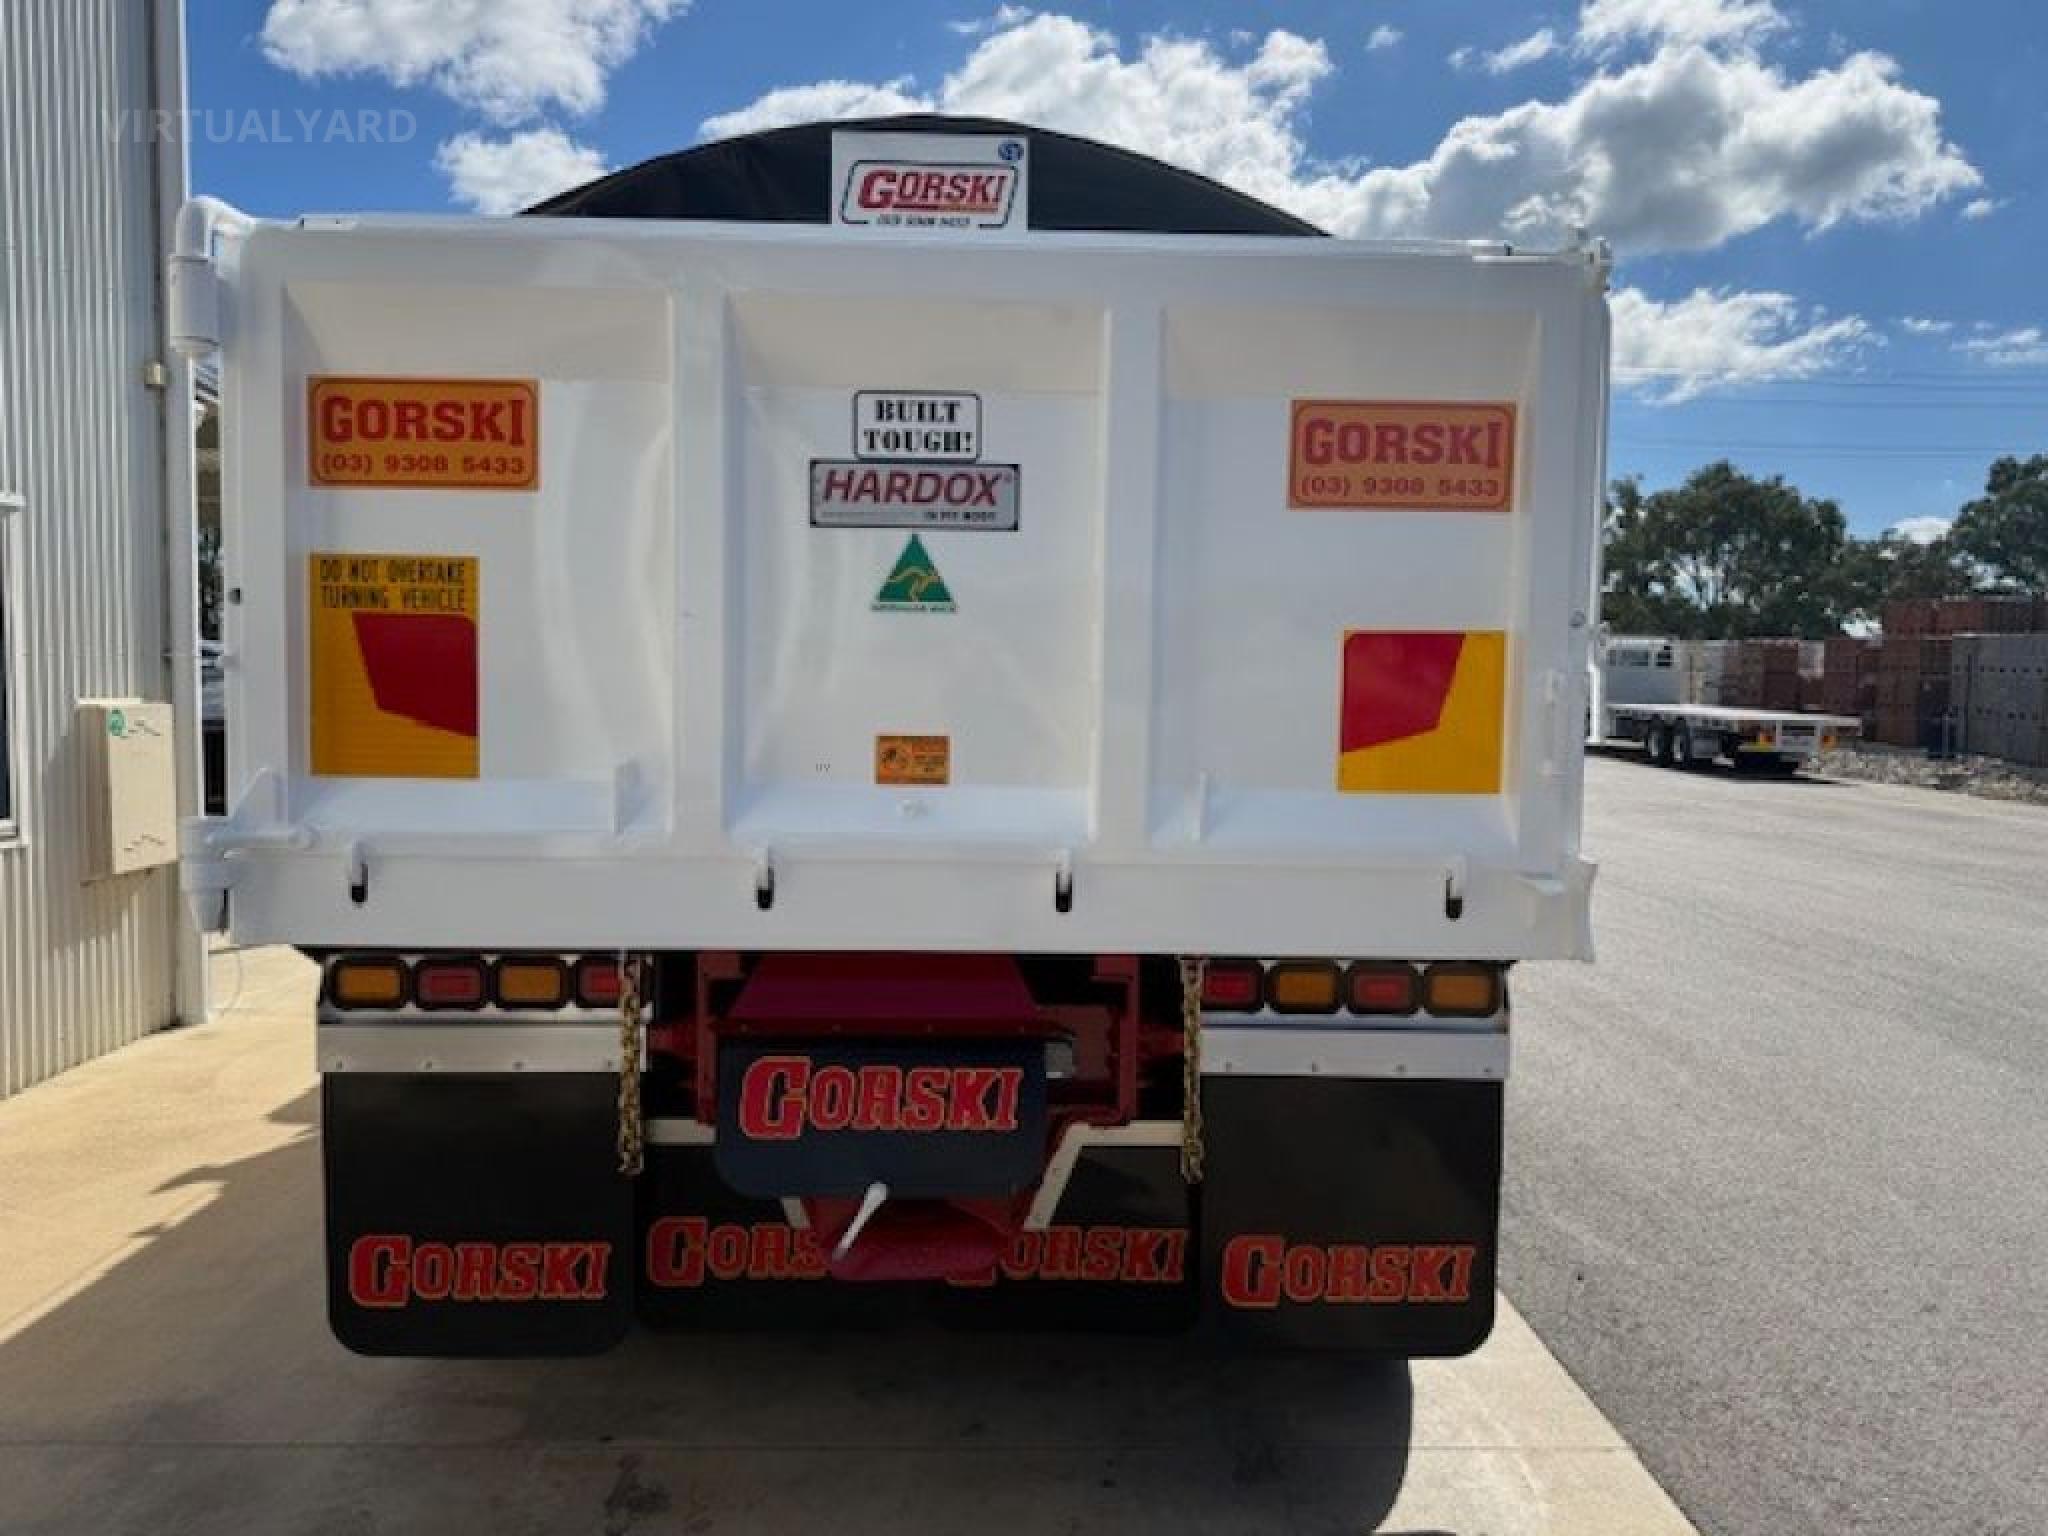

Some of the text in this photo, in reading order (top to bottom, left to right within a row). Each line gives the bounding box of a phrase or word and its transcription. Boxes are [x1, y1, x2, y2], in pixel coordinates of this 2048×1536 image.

[857, 169, 1007, 208] GORSKI
[322, 396, 524, 446] GORSKI
[875, 400, 960, 423] BUILT
[863, 428, 973, 453] TOUGH!
[1304, 418, 1502, 470] GORSKI
[320, 453, 524, 475] (03) 9308 5433
[1301, 475, 1351, 496] (03)
[319, 560, 465, 585] DO NOT OVERTAKE
[320, 586, 465, 611] TURNING VEHICLE
[739, 1056, 1023, 1140] GORSKI
[349, 1235, 612, 1307] GORSKI
[1222, 1234, 1476, 1307] GORSKI
